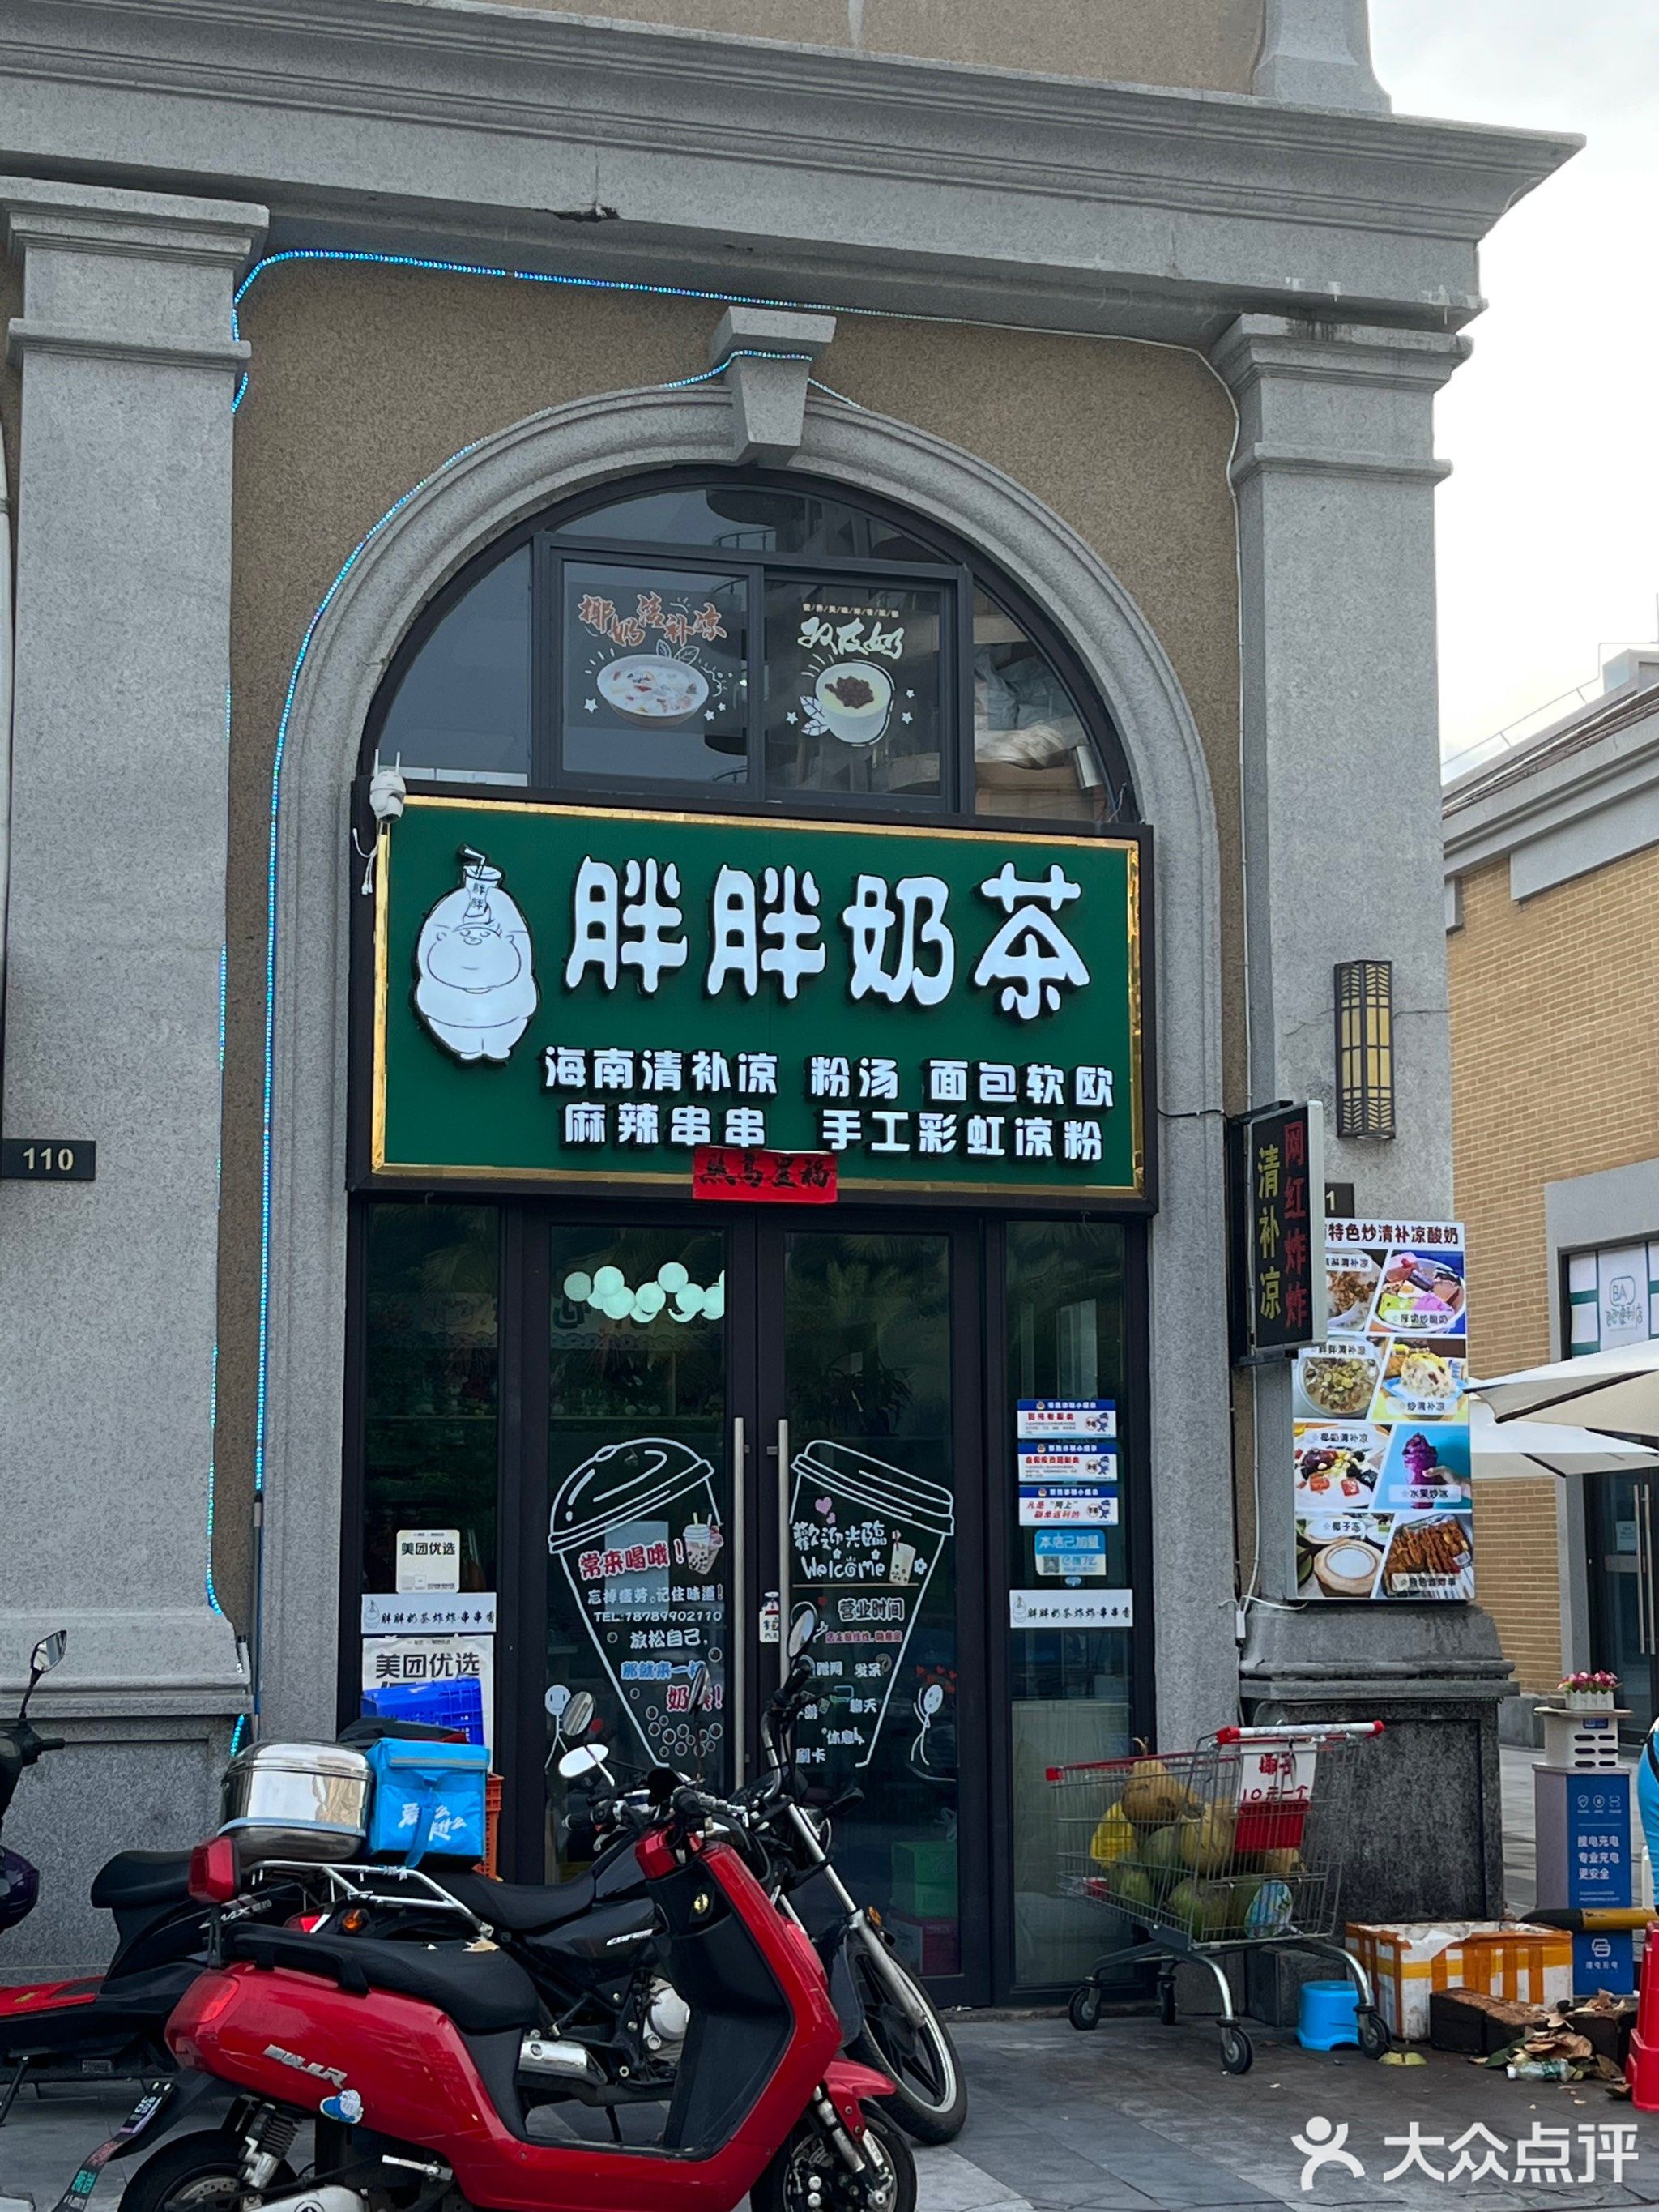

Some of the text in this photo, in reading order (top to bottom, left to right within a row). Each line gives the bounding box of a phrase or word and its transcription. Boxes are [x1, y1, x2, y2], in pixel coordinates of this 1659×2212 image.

[578, 591, 727, 647] 椰奶清补凉
[797, 617, 904, 660] 双皮奶
[564, 854, 1090, 1021] 胖胖奶茶
[545, 1047, 1113, 1108] 海南清补凉 粉汤 面包软欧
[565, 1101, 1102, 1162] 麻辣串串 手工彩虹凉粉
[23, 1147, 74, 1171] 110
[1257, 1143, 1282, 1320] 清补凉
[1284, 1121, 1309, 1330] 网红炸炸
[1326, 1223, 1458, 1245] 特色炒清补凉酸奶
[401, 1541, 456, 1557] 美团优选
[838, 1597, 905, 1622] 营业时间
[376, 1651, 480, 1679] 美团优选
[855, 1662, 881, 1678] 发呆
[849, 1698, 877, 1714] 聊天
[795, 1748, 826, 1764] 刷卡
[1243, 1783, 1309, 1802] 10元一个
[1578, 1851, 1620, 1864] 专业充电
[1579, 1867, 1610, 1881] 更安全
